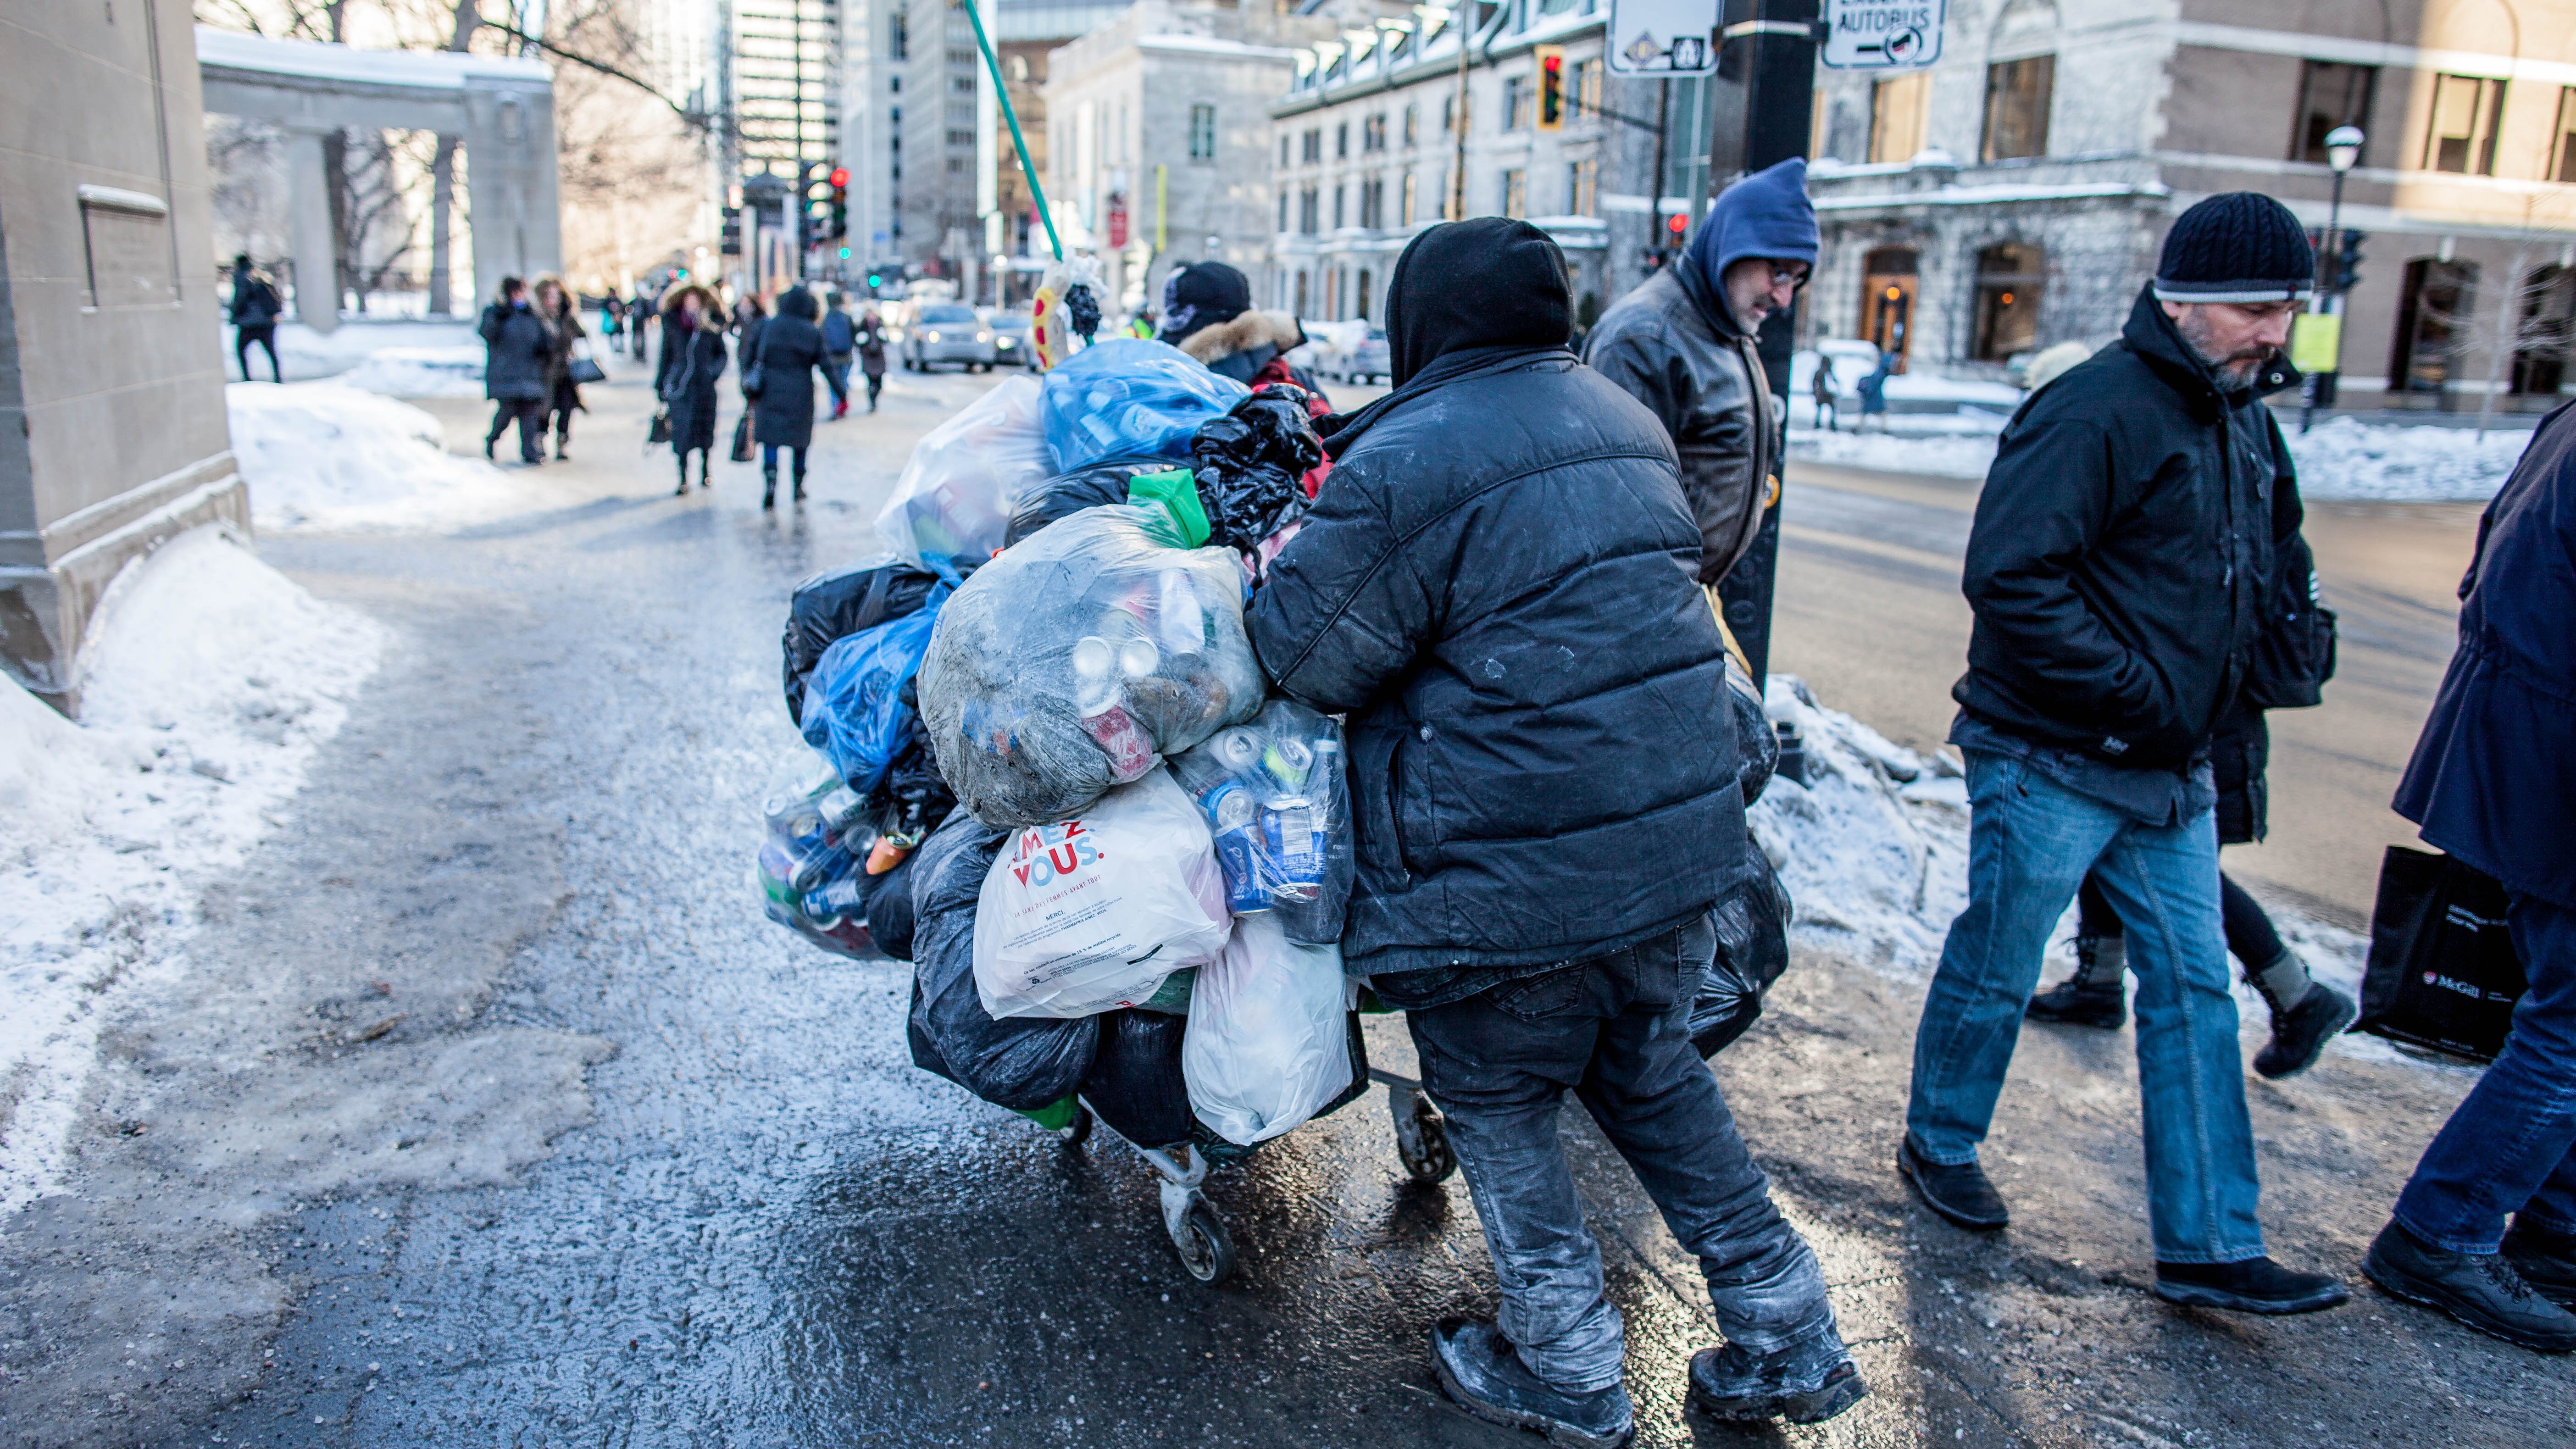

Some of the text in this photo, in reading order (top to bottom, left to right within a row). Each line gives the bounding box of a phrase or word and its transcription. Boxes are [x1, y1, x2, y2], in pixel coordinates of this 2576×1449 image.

[1836, 7, 1929, 33] AUTOBUS
[1013, 837, 1104, 890] VOUS.
[1035, 900, 1046, 909] DES
[1046, 890, 1067, 903] FEMMES
[1070, 882, 1087, 894] AVANT
[1088, 874, 1101, 885] TOUT
[1046, 910, 1065, 921] MERCI.
[1061, 919, 1084, 931] PHARMAPRIX
[1093, 939, 1106, 948] matière
[1106, 933, 1121, 942] recyclée
[2437, 975, 2479, 999] McGill
